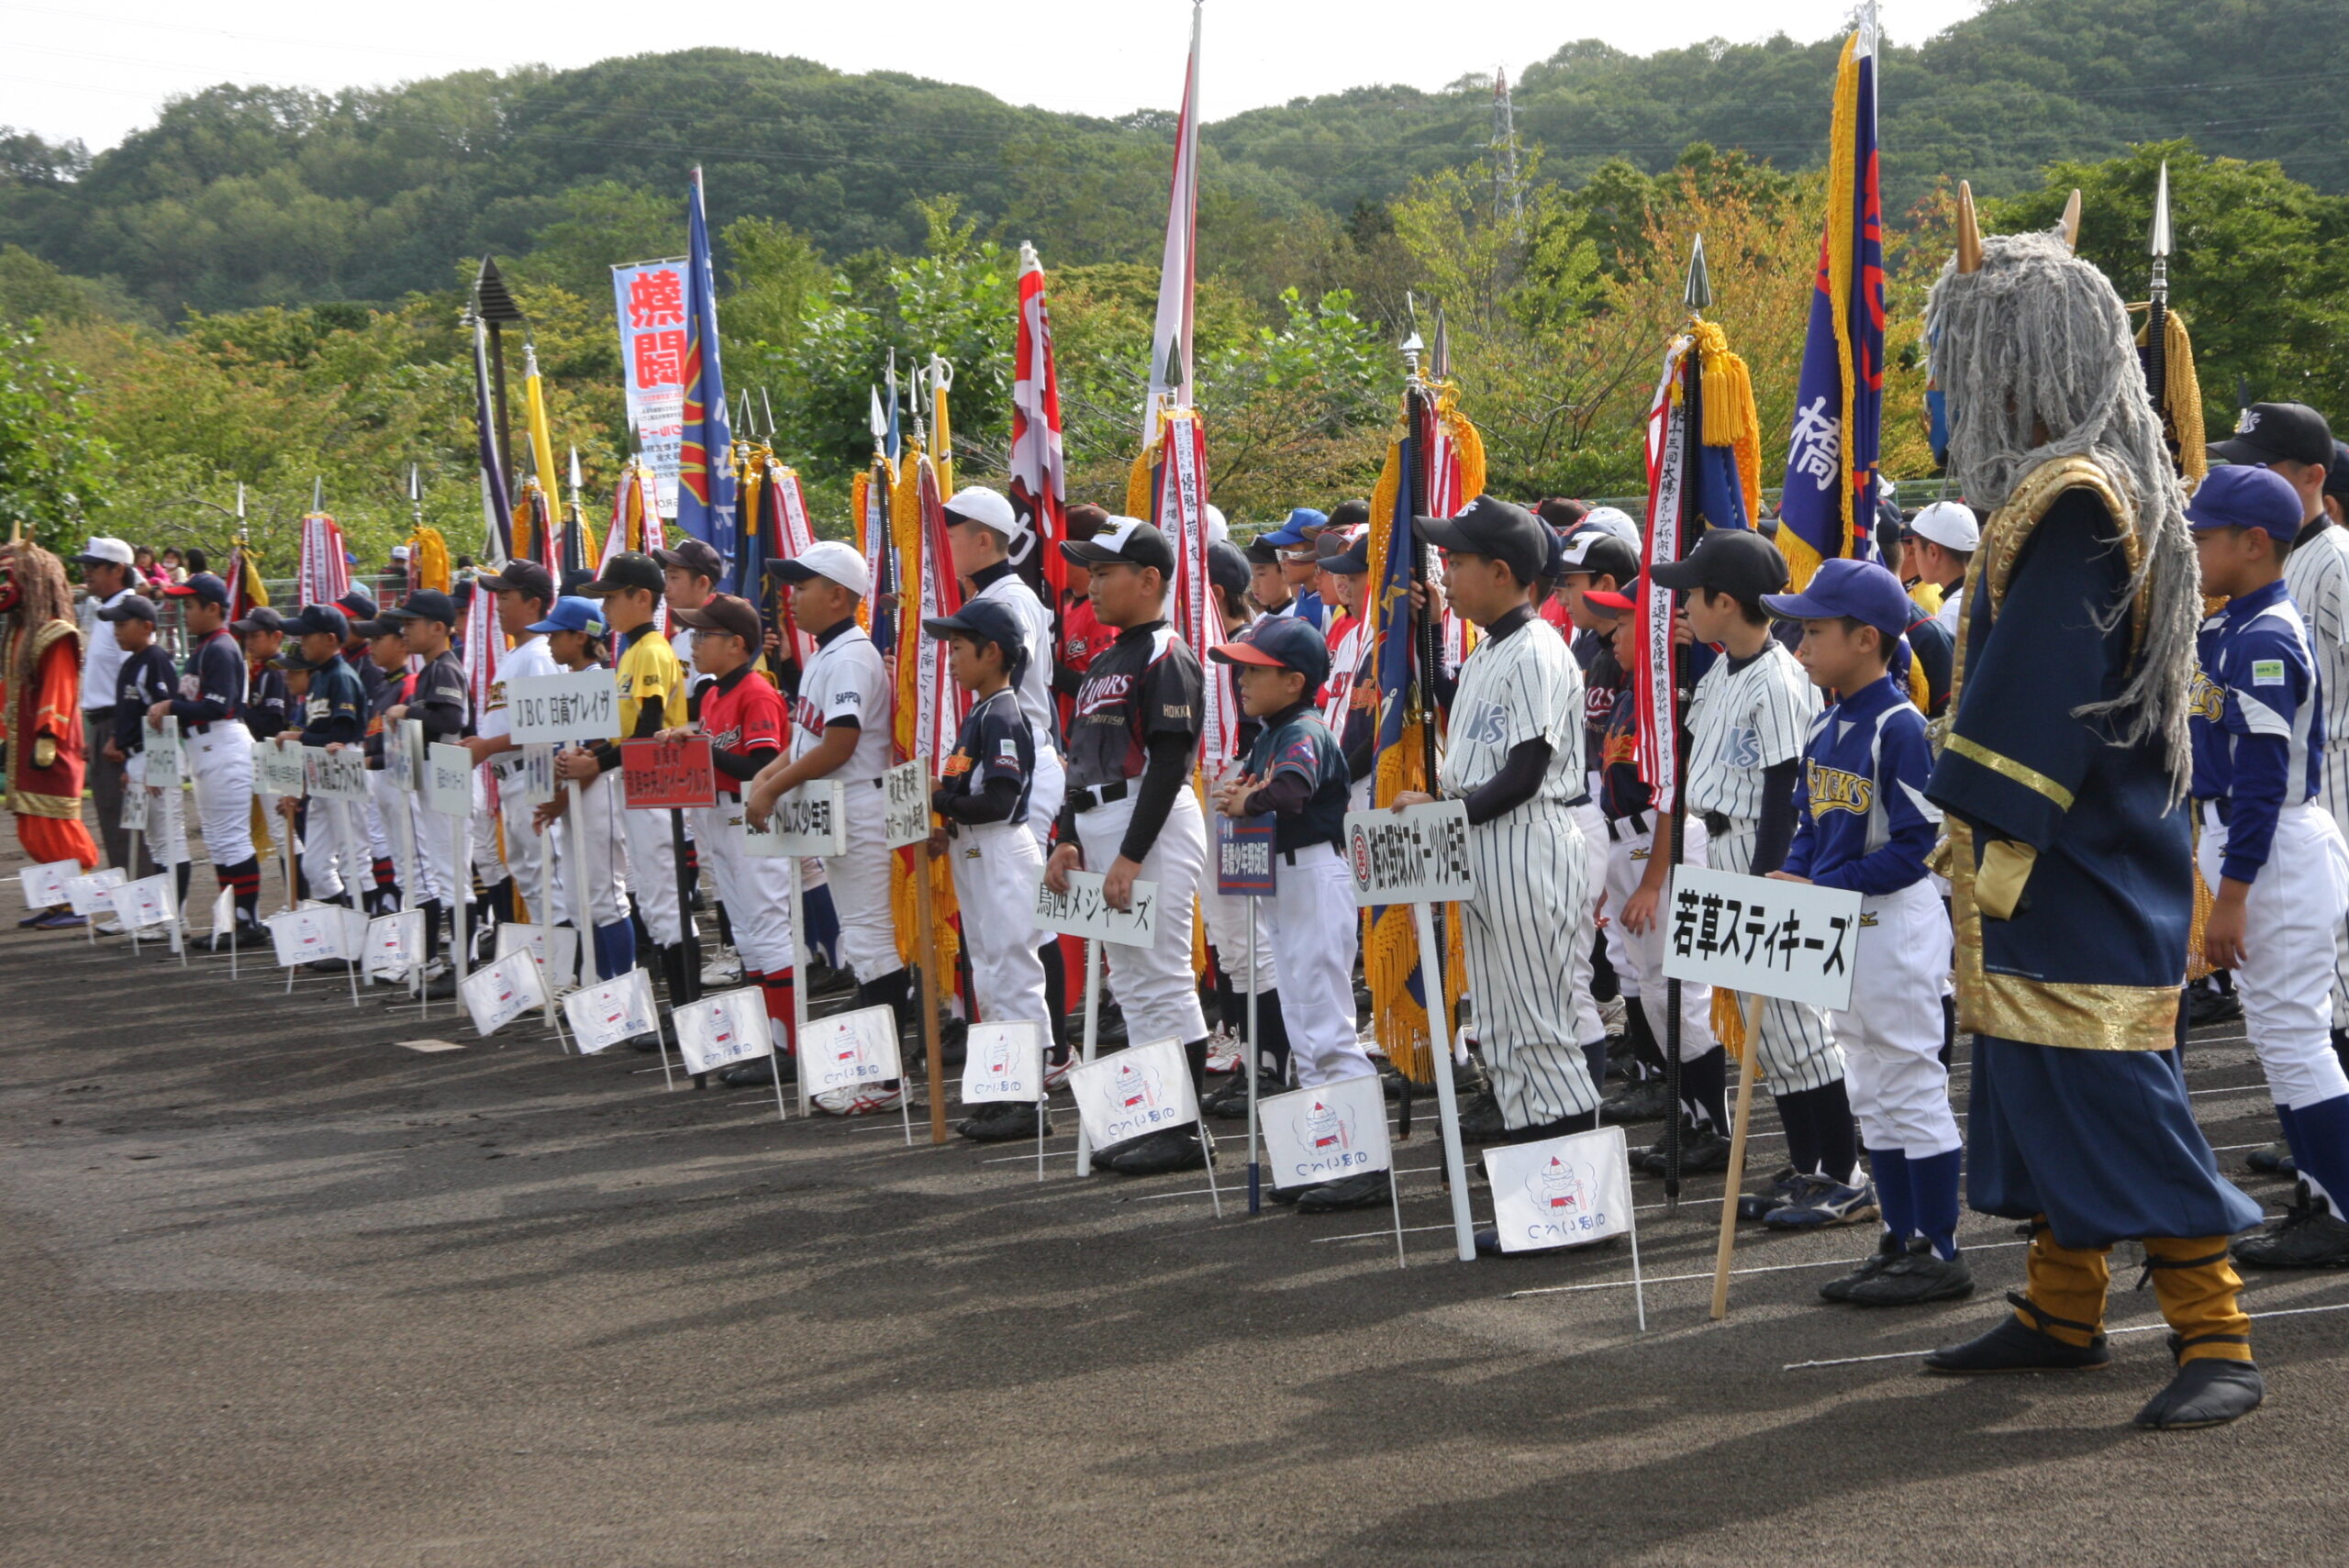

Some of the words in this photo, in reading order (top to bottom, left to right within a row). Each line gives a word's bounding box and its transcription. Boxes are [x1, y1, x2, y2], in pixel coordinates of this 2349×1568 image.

[517, 697, 545, 728] JBC
[1221, 842, 1269, 876] 長橋少年野球団
[1673, 888, 1854, 977] 若草スティキーズ
